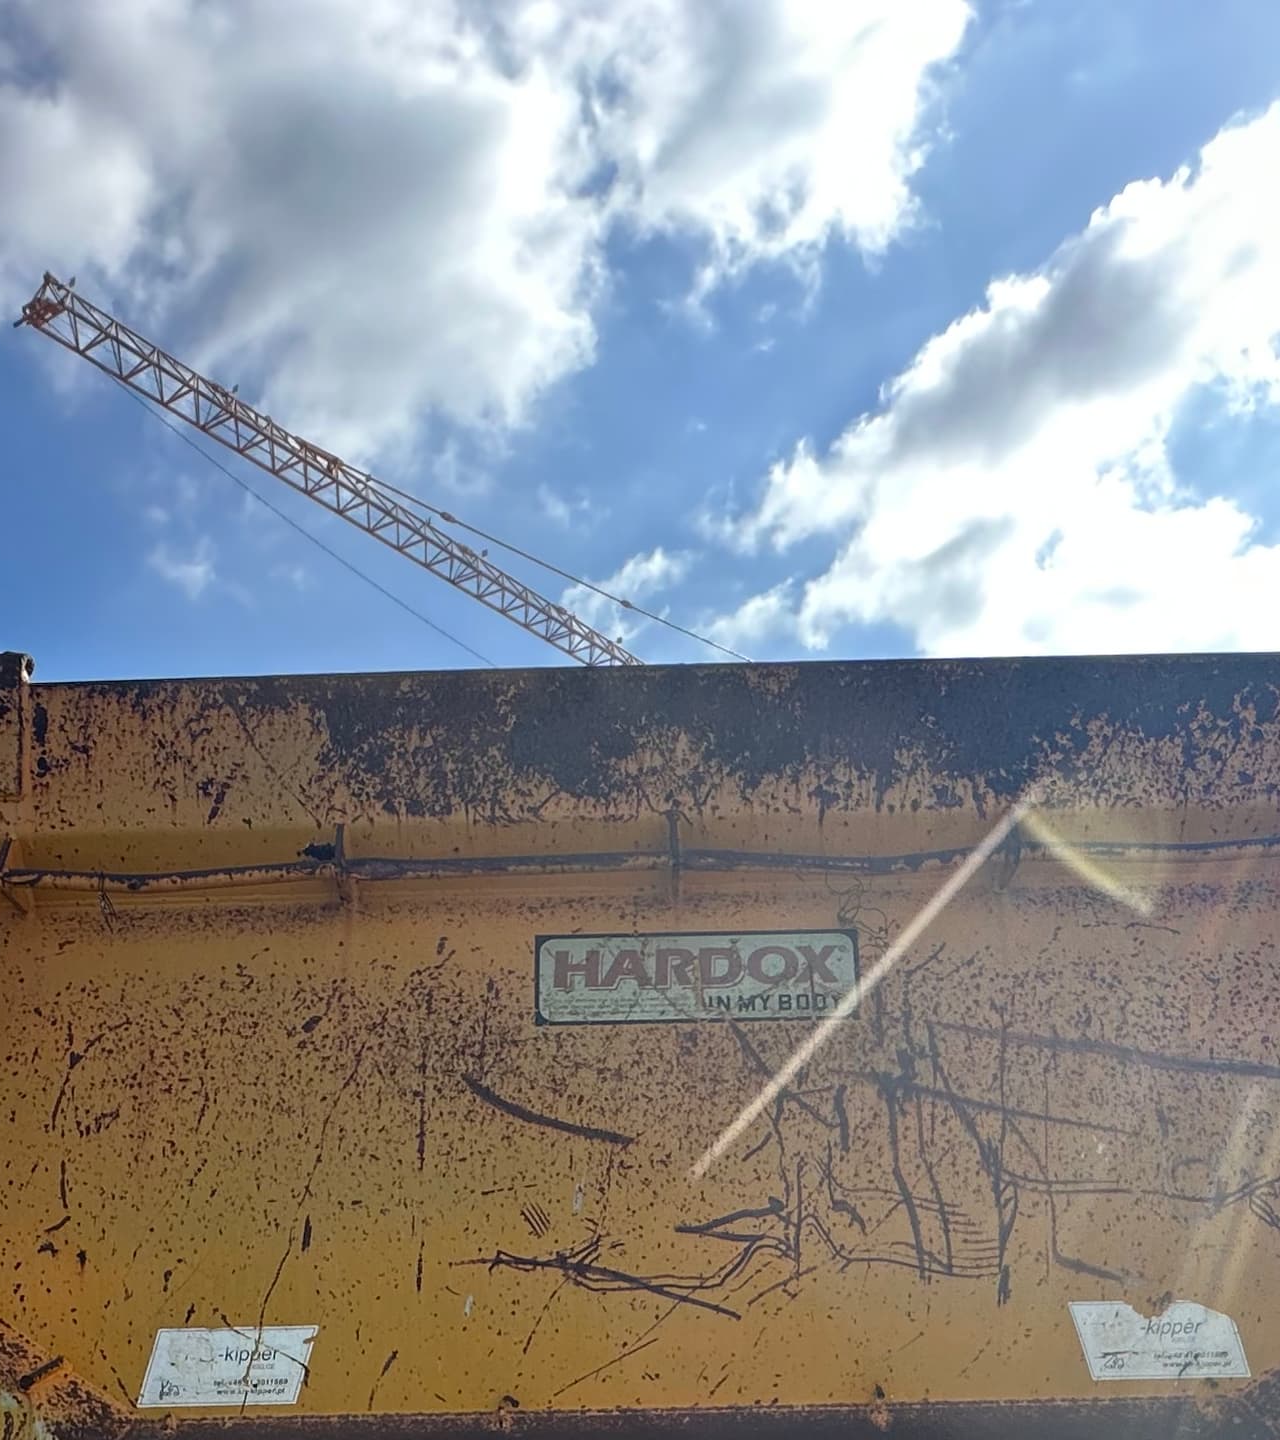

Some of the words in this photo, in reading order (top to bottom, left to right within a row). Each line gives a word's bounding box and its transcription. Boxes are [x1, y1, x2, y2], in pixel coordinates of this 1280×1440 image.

[553, 944, 841, 991] HARDOX
[708, 995, 731, 1011] IN
[739, 994, 769, 1013] MY
[778, 993, 841, 1012] BODY
